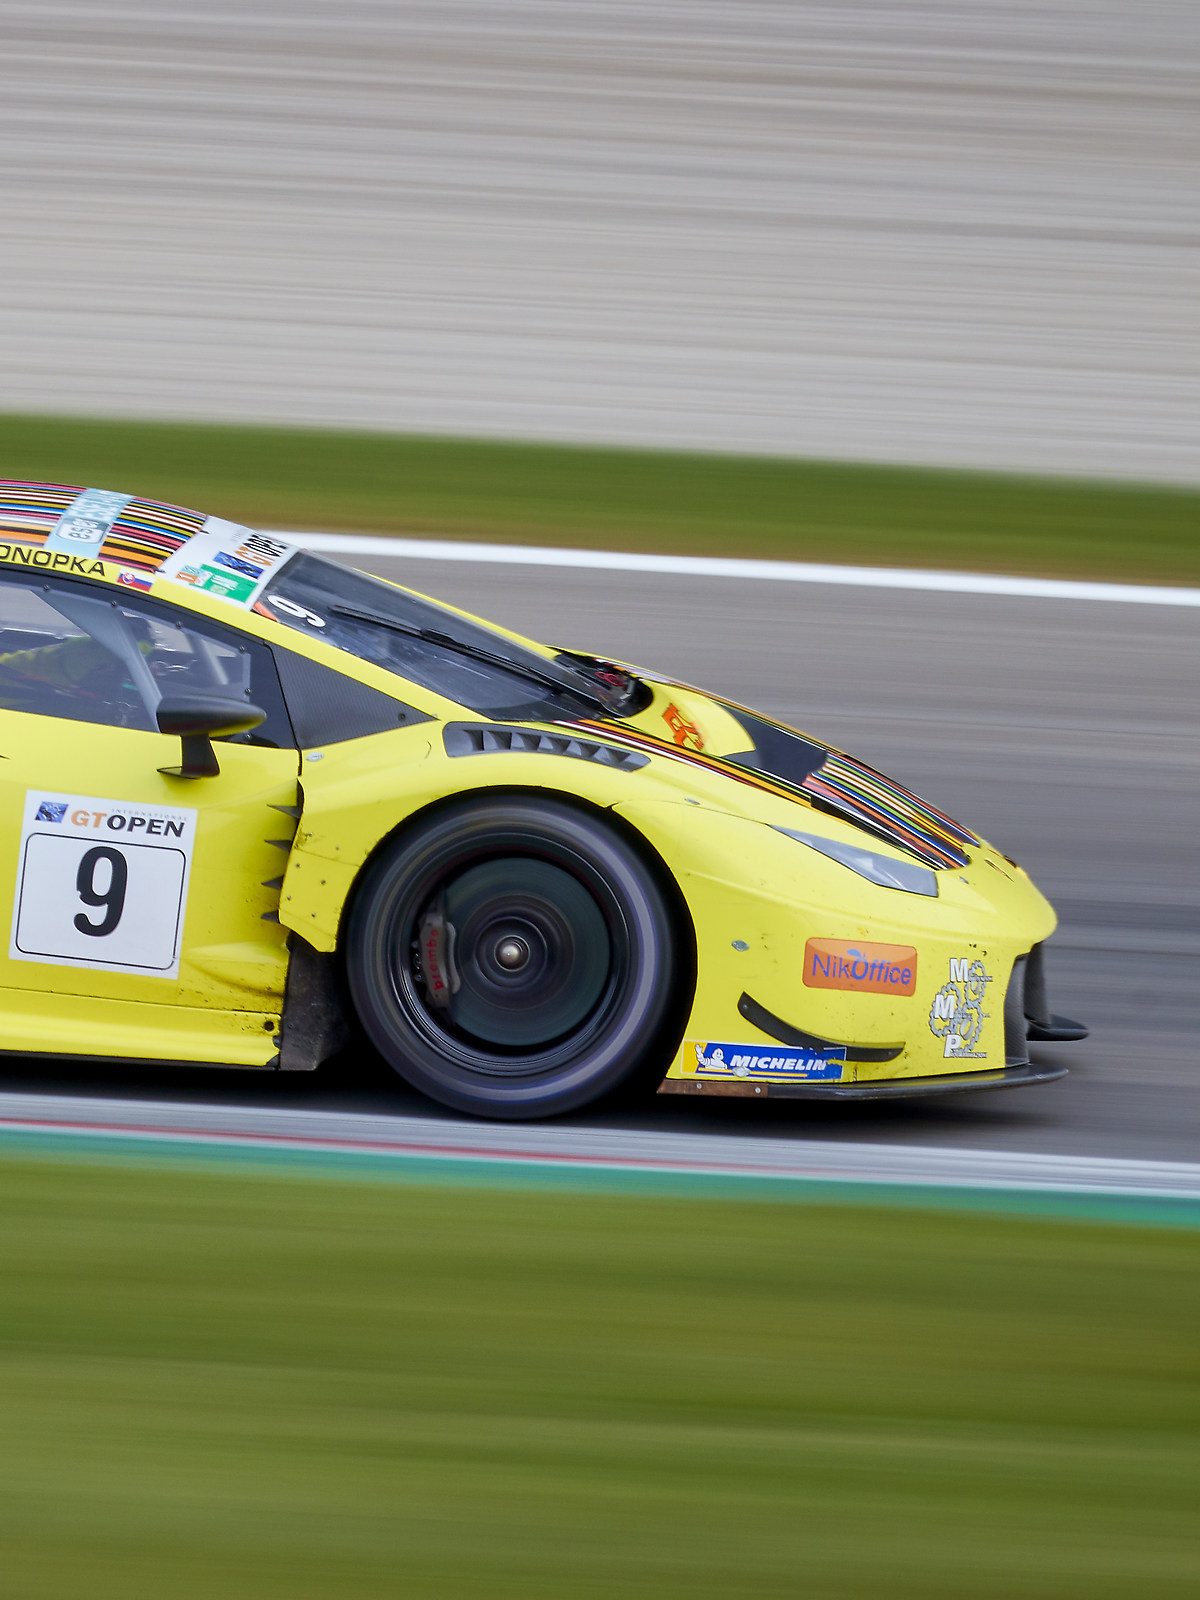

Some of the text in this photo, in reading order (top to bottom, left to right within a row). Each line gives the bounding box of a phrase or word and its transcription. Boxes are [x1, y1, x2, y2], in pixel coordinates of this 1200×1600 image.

[267, 594, 326, 627] 9
[73, 846, 128, 937] 9
[426, 929, 444, 990] brembo
[812, 952, 912, 985] NikOffice
[730, 1054, 828, 1071] MICHELIN
